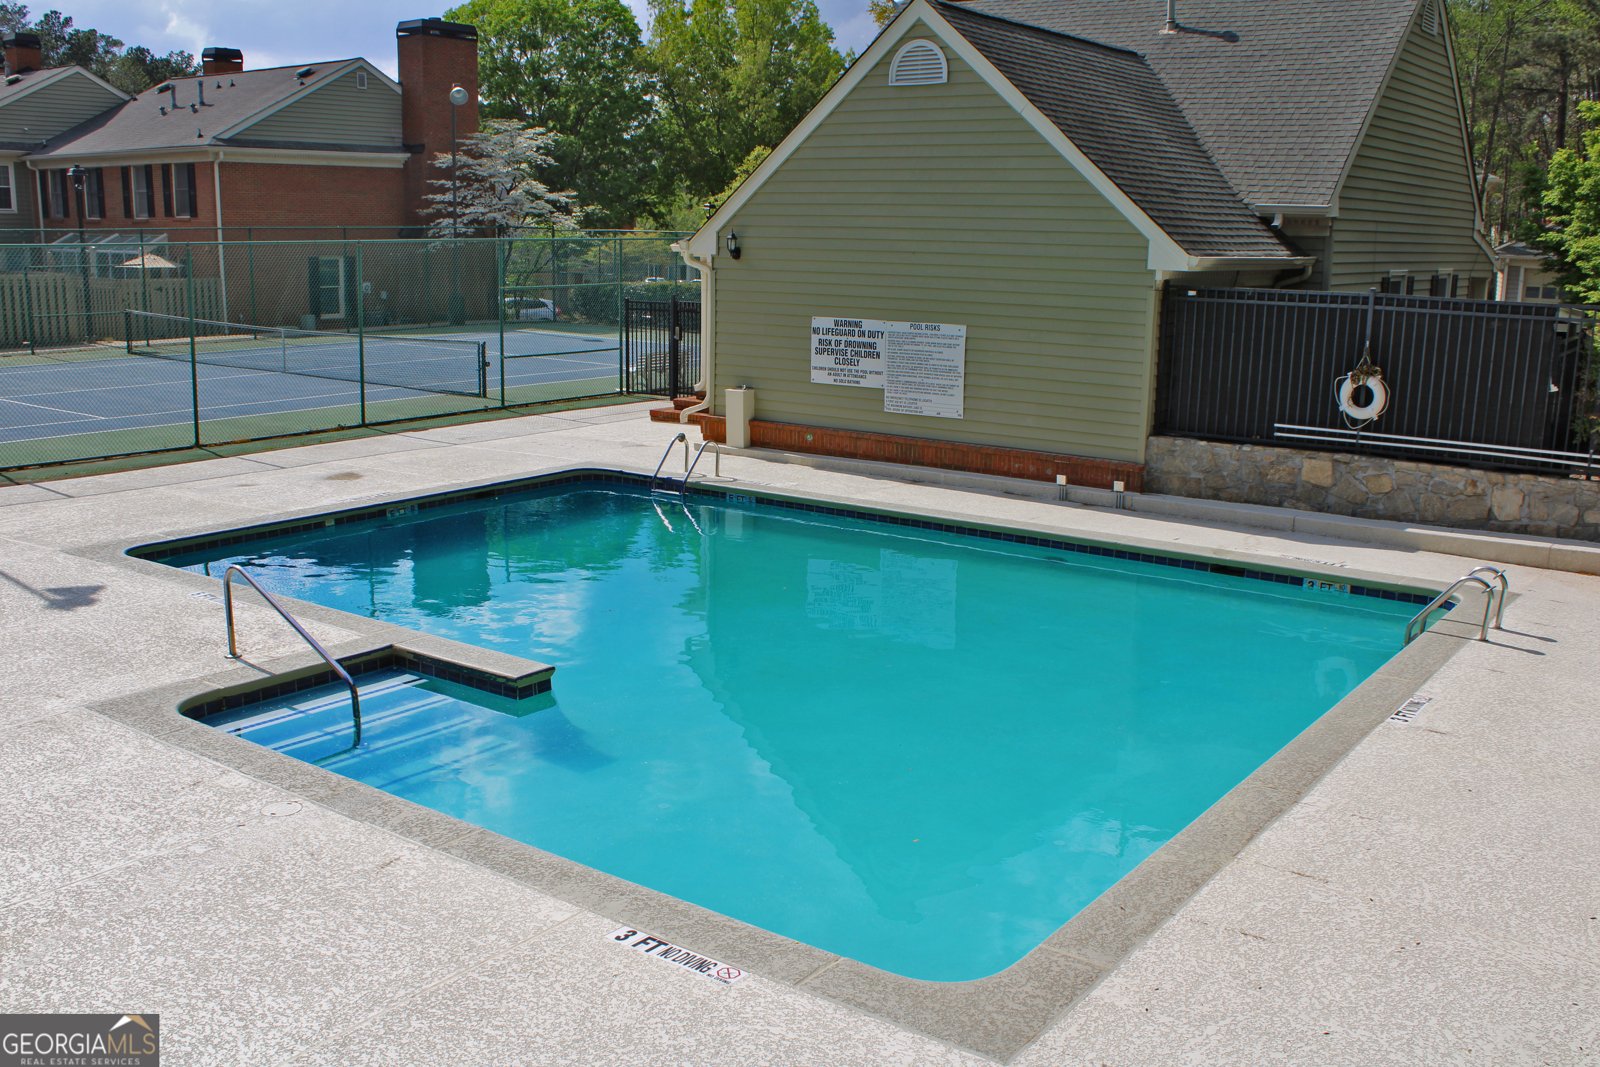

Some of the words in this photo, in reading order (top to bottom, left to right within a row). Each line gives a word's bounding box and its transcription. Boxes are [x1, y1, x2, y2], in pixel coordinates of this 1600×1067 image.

[833, 319, 863, 329] WARNING
[909, 323, 924, 331] POOL
[924, 323, 941, 332] RISKS
[812, 326, 821, 335] NO
[821, 327, 856, 338] LIFEGUARD
[857, 329, 866, 338] ON
[867, 330, 885, 339] DUTY
[818, 338, 833, 347] RISK
[834, 339, 843, 348] OF
[844, 340, 877, 350] DROWNING
[814, 347, 849, 357] SUPERVISE
[850, 349, 881, 360] CHILDREN
[834, 357, 860, 367] CLOSELY
[614, 929, 638, 941] 3
[631, 936, 670, 953] FT
[656, 946, 682, 960] NO
[671, 952, 718, 974] DIVING
